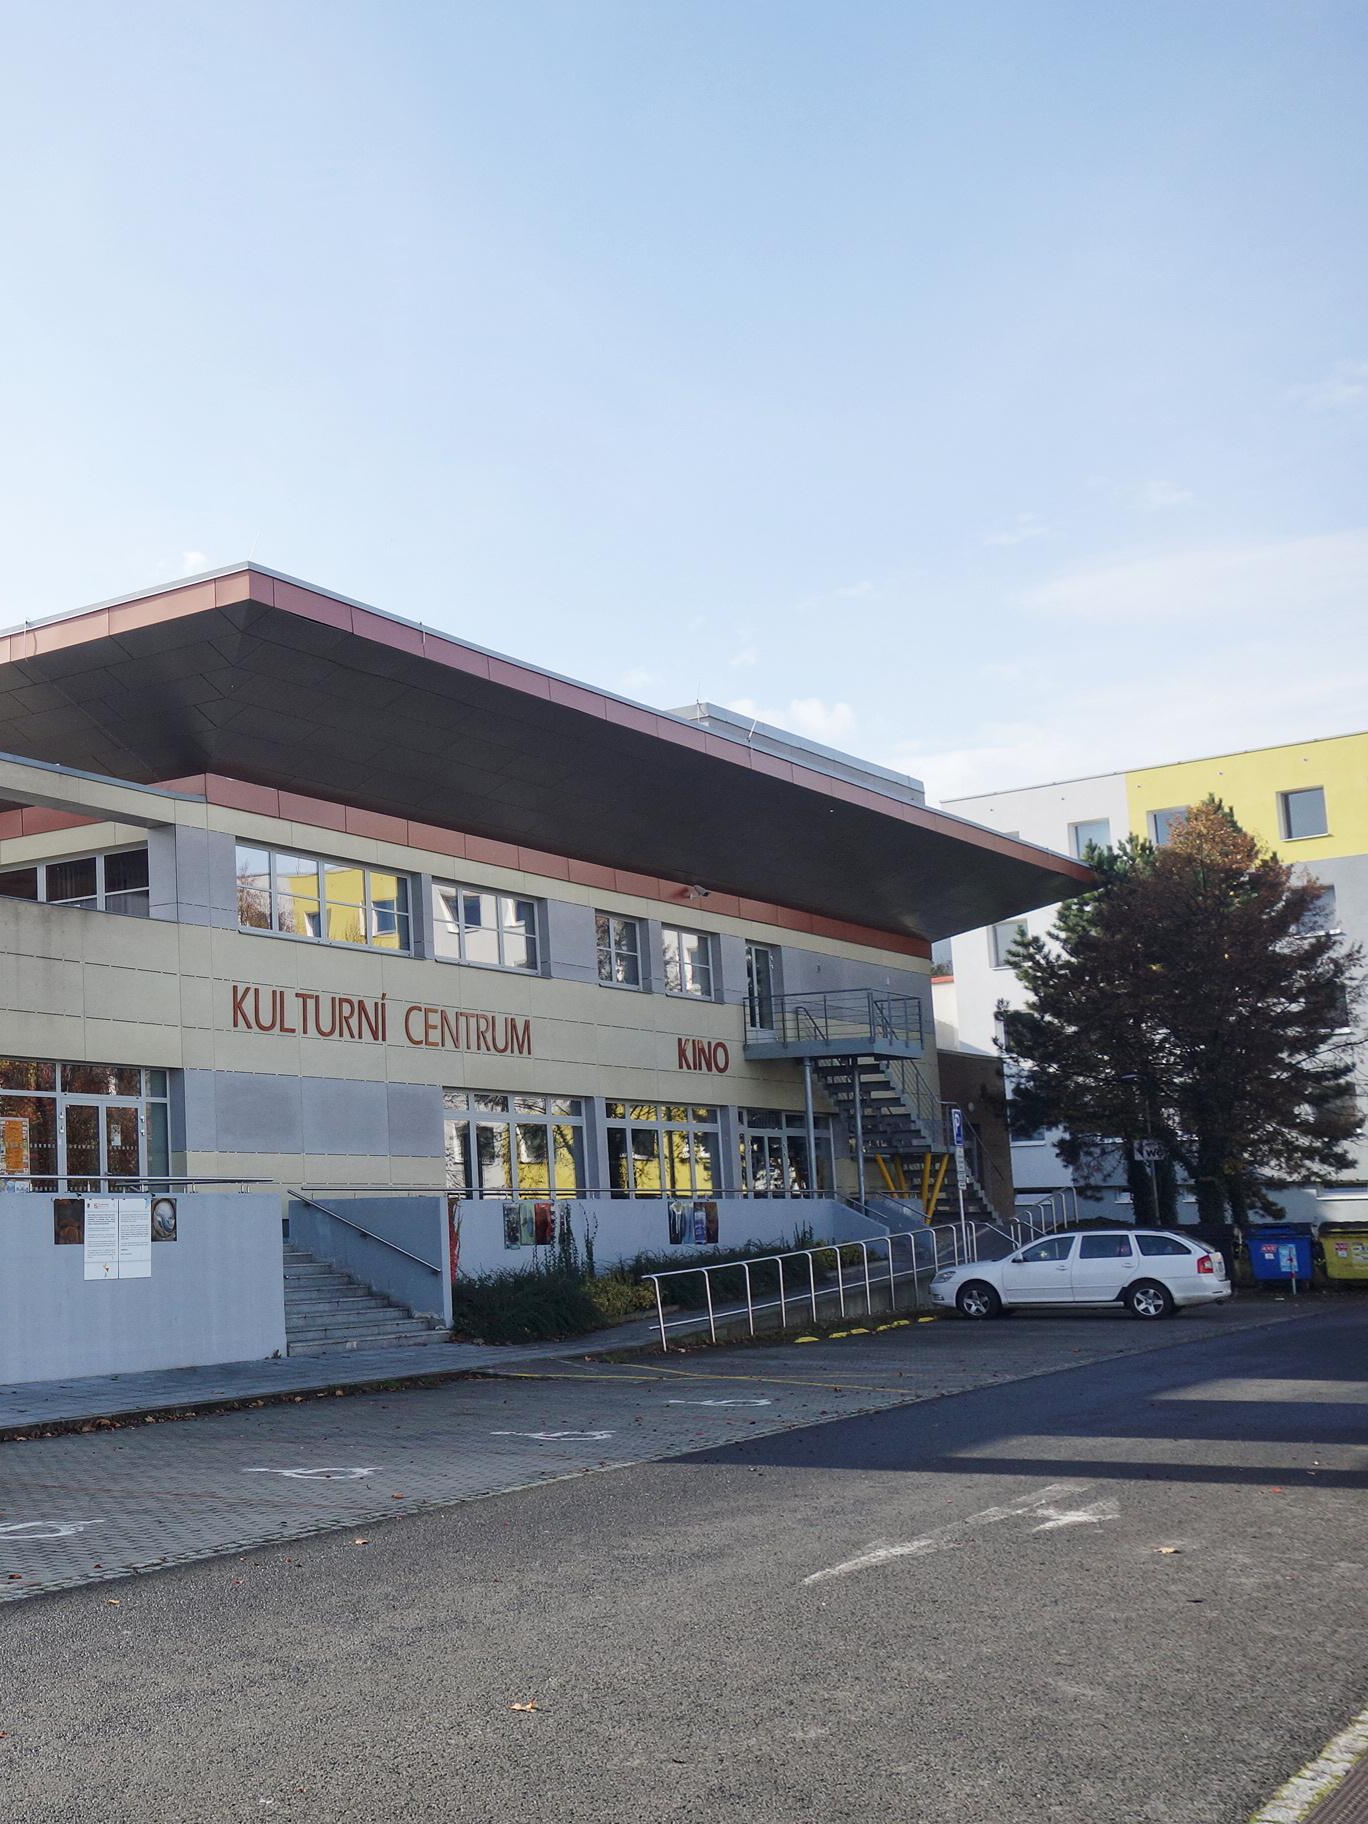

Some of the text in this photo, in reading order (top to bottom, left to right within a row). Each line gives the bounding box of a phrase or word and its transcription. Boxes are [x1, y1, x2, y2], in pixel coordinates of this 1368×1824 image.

[232, 985, 532, 1055] KULTURNÍ CENTRUM
[677, 1037, 730, 1073] KINO
